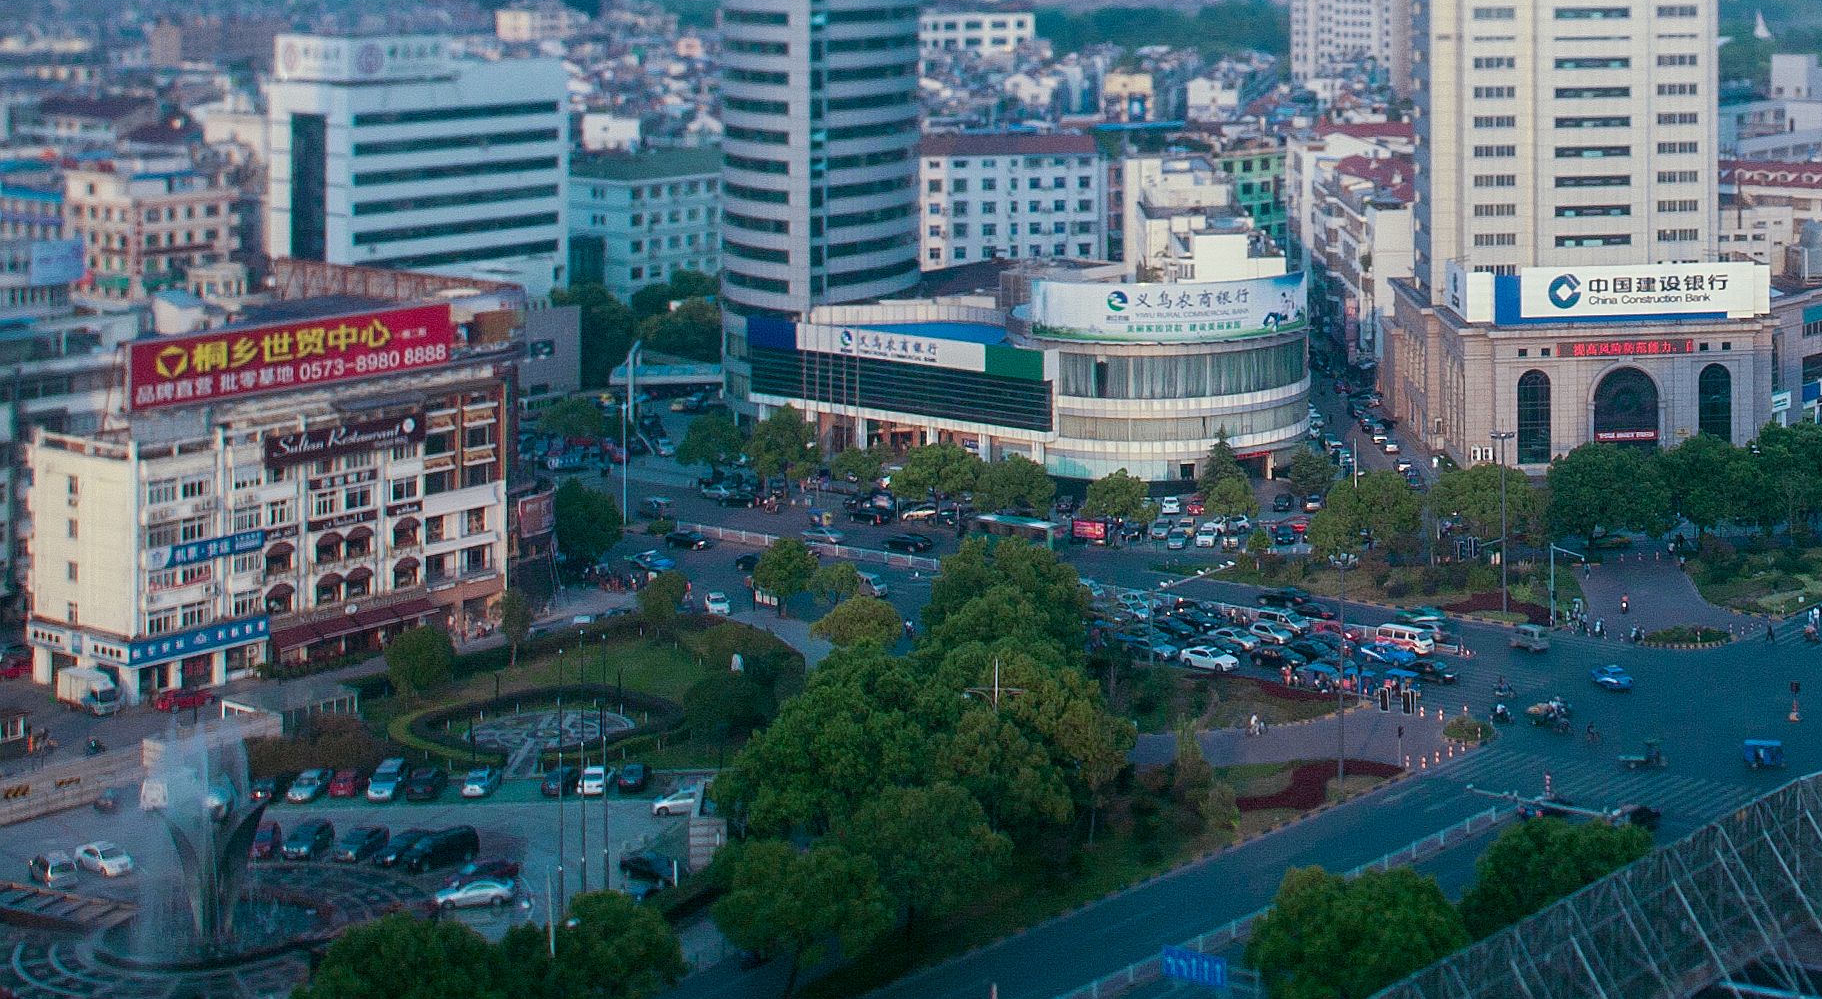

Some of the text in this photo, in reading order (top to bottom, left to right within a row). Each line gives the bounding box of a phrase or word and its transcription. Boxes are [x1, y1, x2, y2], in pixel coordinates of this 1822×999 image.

[1589, 274, 1729, 293] 中国建设银行
[1135, 288, 1250, 309] 义乌农商银行
[1589, 292, 1711, 305] China Construction Bank
[193, 316, 392, 373] 桐乡世贸中心
[299, 350, 400, 382] 0573-8980
[404, 343, 447, 364] 8888
